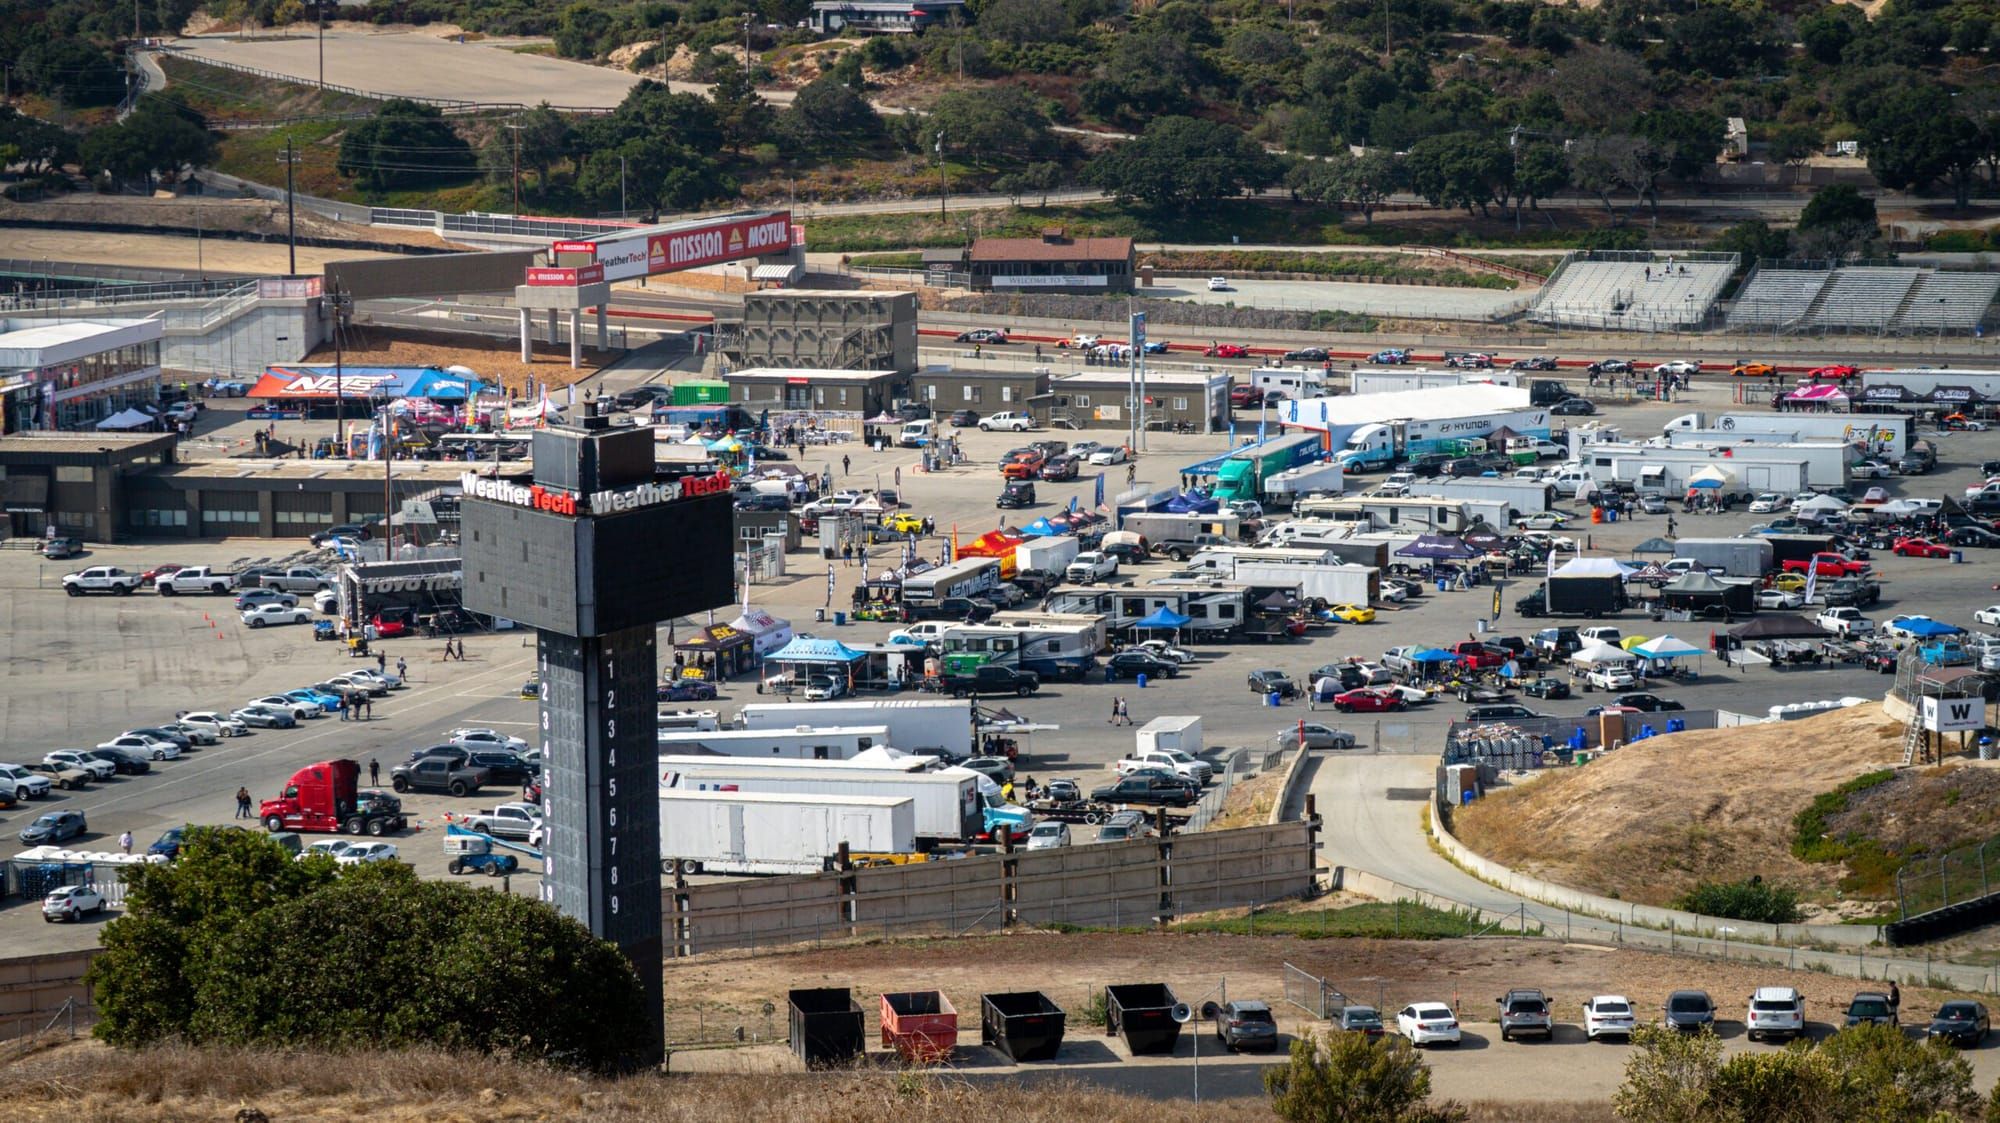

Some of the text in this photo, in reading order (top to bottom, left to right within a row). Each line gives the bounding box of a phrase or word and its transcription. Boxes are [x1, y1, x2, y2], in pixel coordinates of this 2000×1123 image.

[748, 221, 787, 248] MOTUL
[670, 230, 722, 264] MISSION
[1454, 420, 1491, 431] HYUNDAI
[461, 471, 577, 515] WeatherTech
[589, 470, 731, 514] WeatherTech
[366, 578, 420, 595] TOYO
[542, 654, 547, 671] 1
[608, 660, 613, 679] 1
[542, 683, 548, 701] 2
[608, 690, 614, 709] 2
[543, 711, 549, 730] 3
[1951, 704, 1971, 720] W
[608, 720, 615, 737] 3
[544, 740, 549, 758] 4
[609, 749, 615, 767] 4
[544, 769, 550, 788] 5
[609, 778, 616, 796] 5
[545, 799, 551, 817] 6
[610, 808, 616, 826] 6
[546, 827, 551, 845] 7
[610, 837, 617, 855] 7
[547, 856, 552, 875] 8
[611, 866, 617, 884] 8
[547, 885, 552, 902] 9
[612, 896, 618, 914] 9
